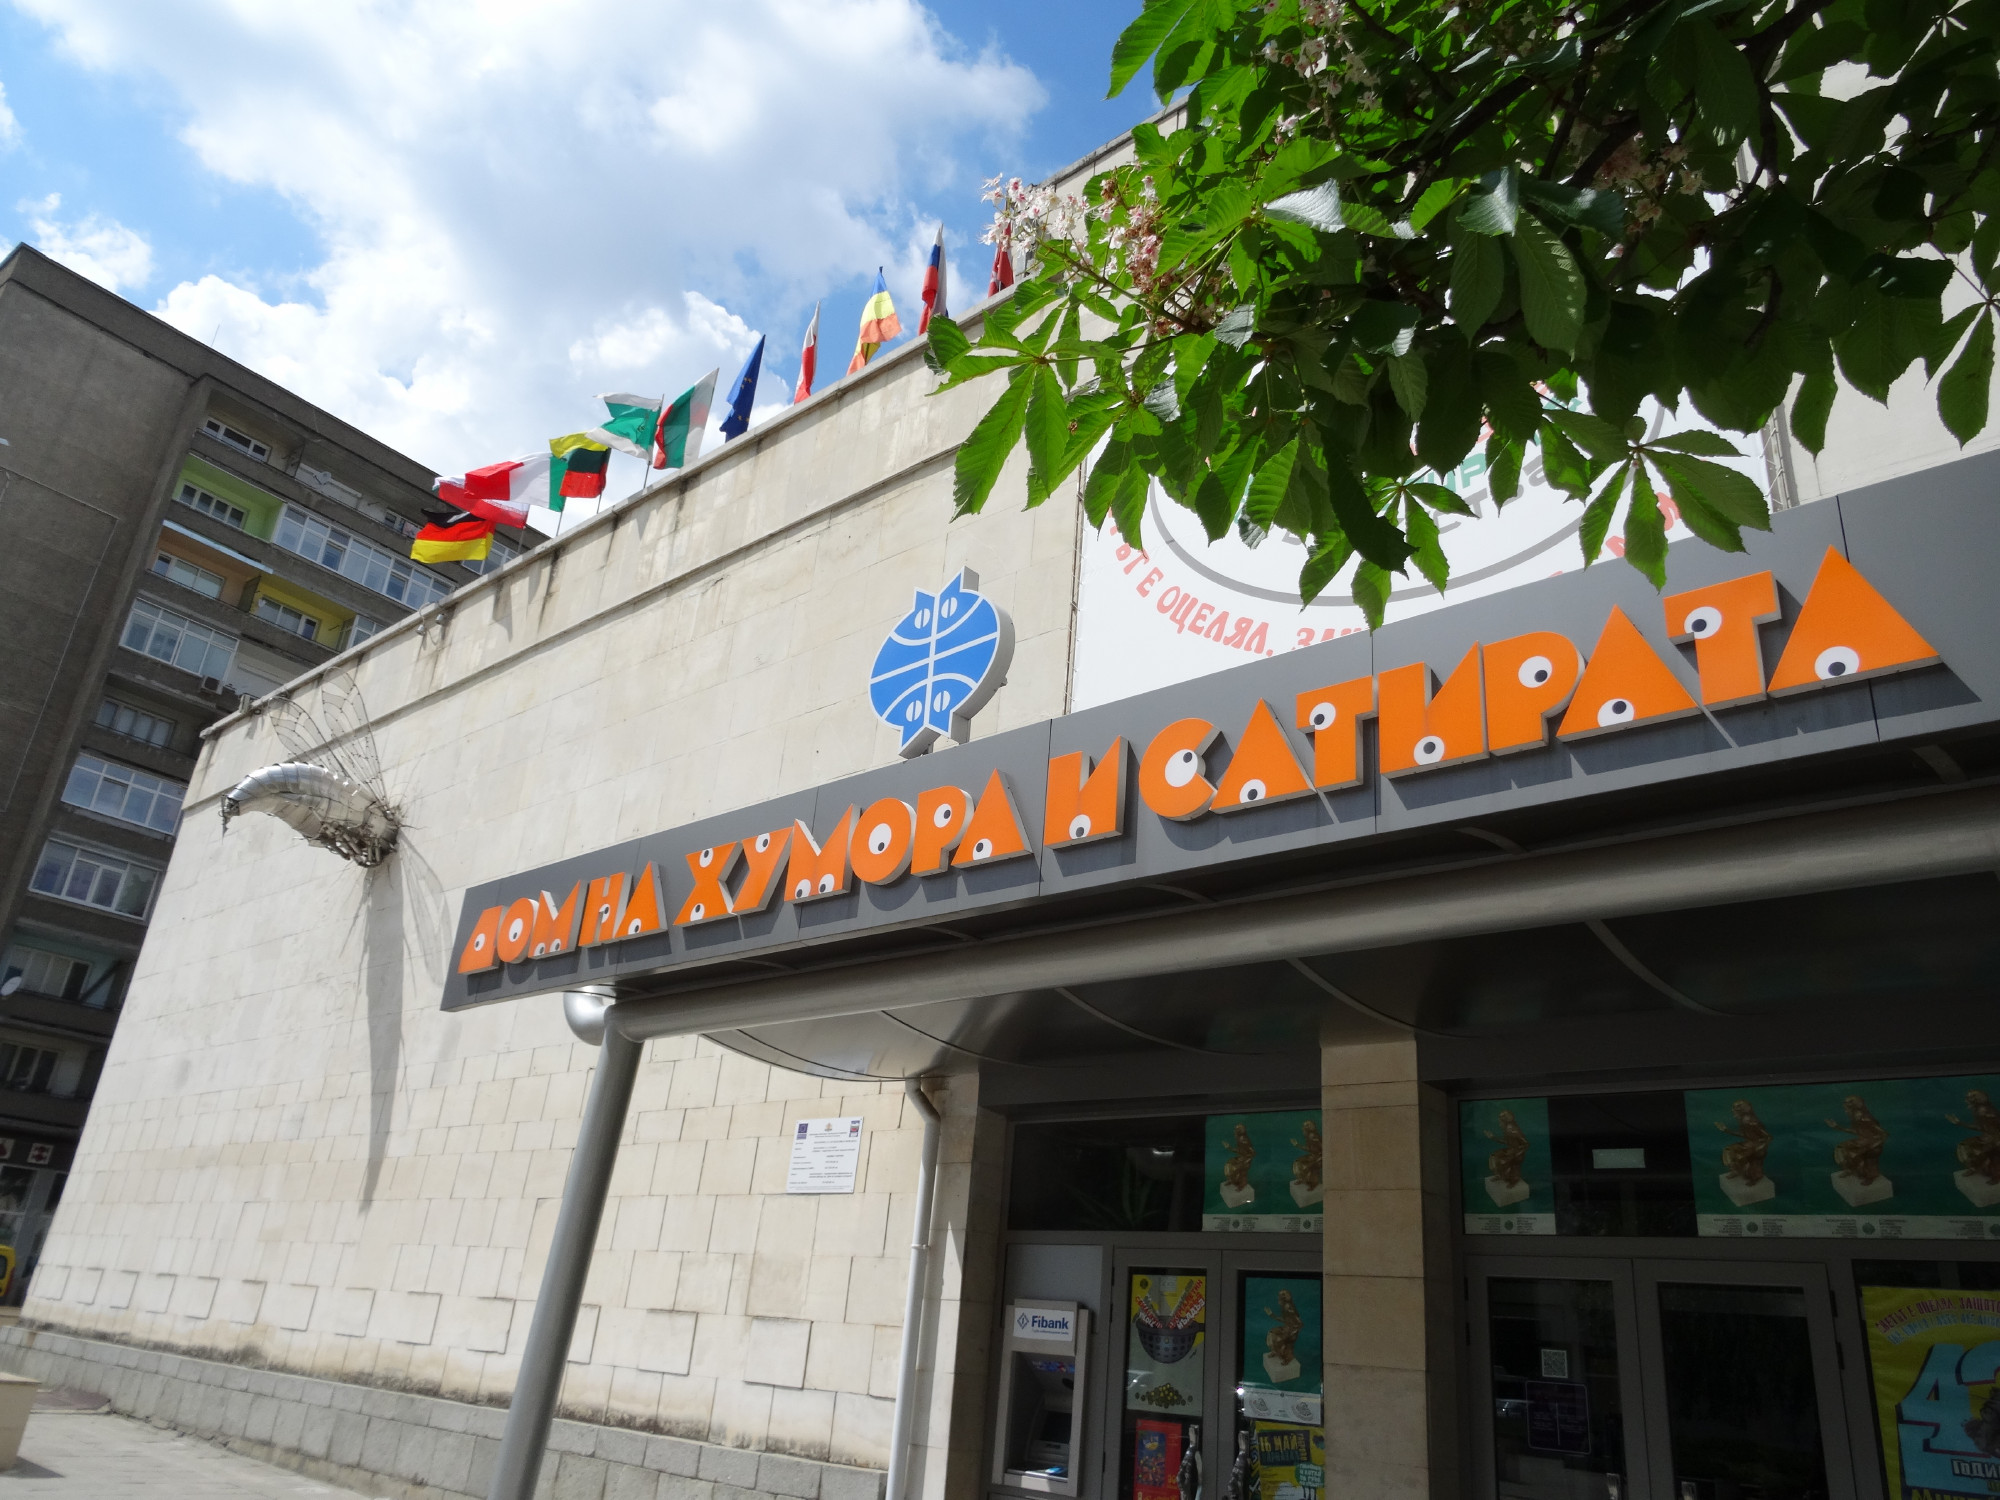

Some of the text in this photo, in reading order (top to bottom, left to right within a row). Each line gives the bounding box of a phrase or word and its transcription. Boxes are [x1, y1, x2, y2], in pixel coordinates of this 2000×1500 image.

[458, 545, 1940, 975] ДОМ НА ХУМОРА И САТИРАТА
[1031, 1315, 1069, 1330] Fibank
